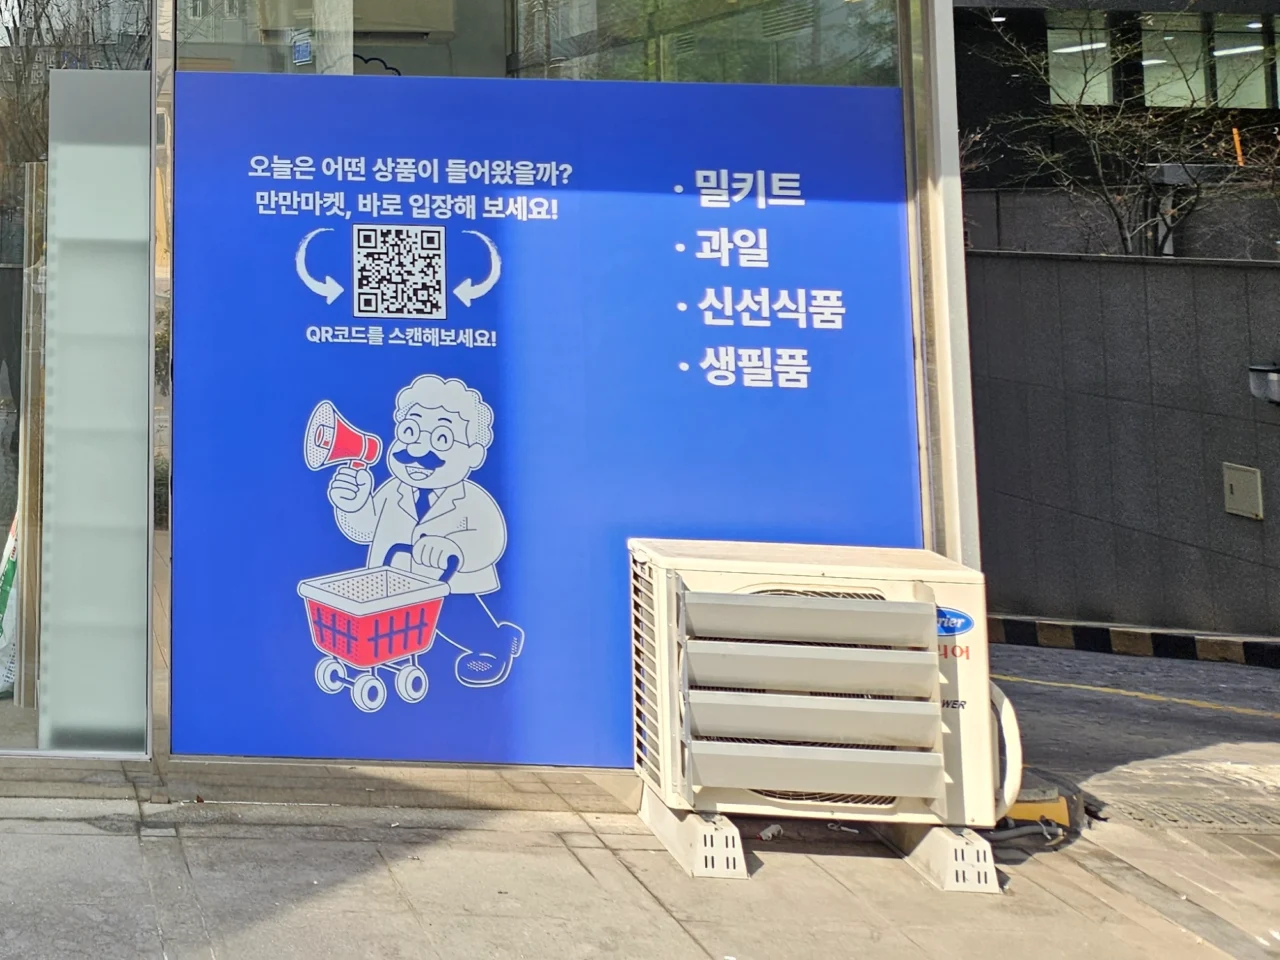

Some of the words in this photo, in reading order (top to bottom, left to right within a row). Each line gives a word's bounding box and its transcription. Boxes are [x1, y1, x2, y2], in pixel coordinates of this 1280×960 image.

[248, 155, 316, 181] 오늘은
[322, 157, 366, 182] 어떤
[372, 158, 439, 184] 상품이
[445, 159, 573, 186] 들어왔을까?
[695, 169, 806, 209] 밀키트
[255, 190, 352, 220] 만만마켓,
[358, 193, 403, 217] 바로
[409, 194, 476, 219] 입장해
[483, 196, 559, 221] 보세요!
[695, 227, 769, 268] 과일
[698, 286, 846, 329] 신선식품
[305, 325, 384, 346] QR코드를
[388, 327, 497, 348] 스캔해보세요!
[699, 346, 812, 388] 생필품
